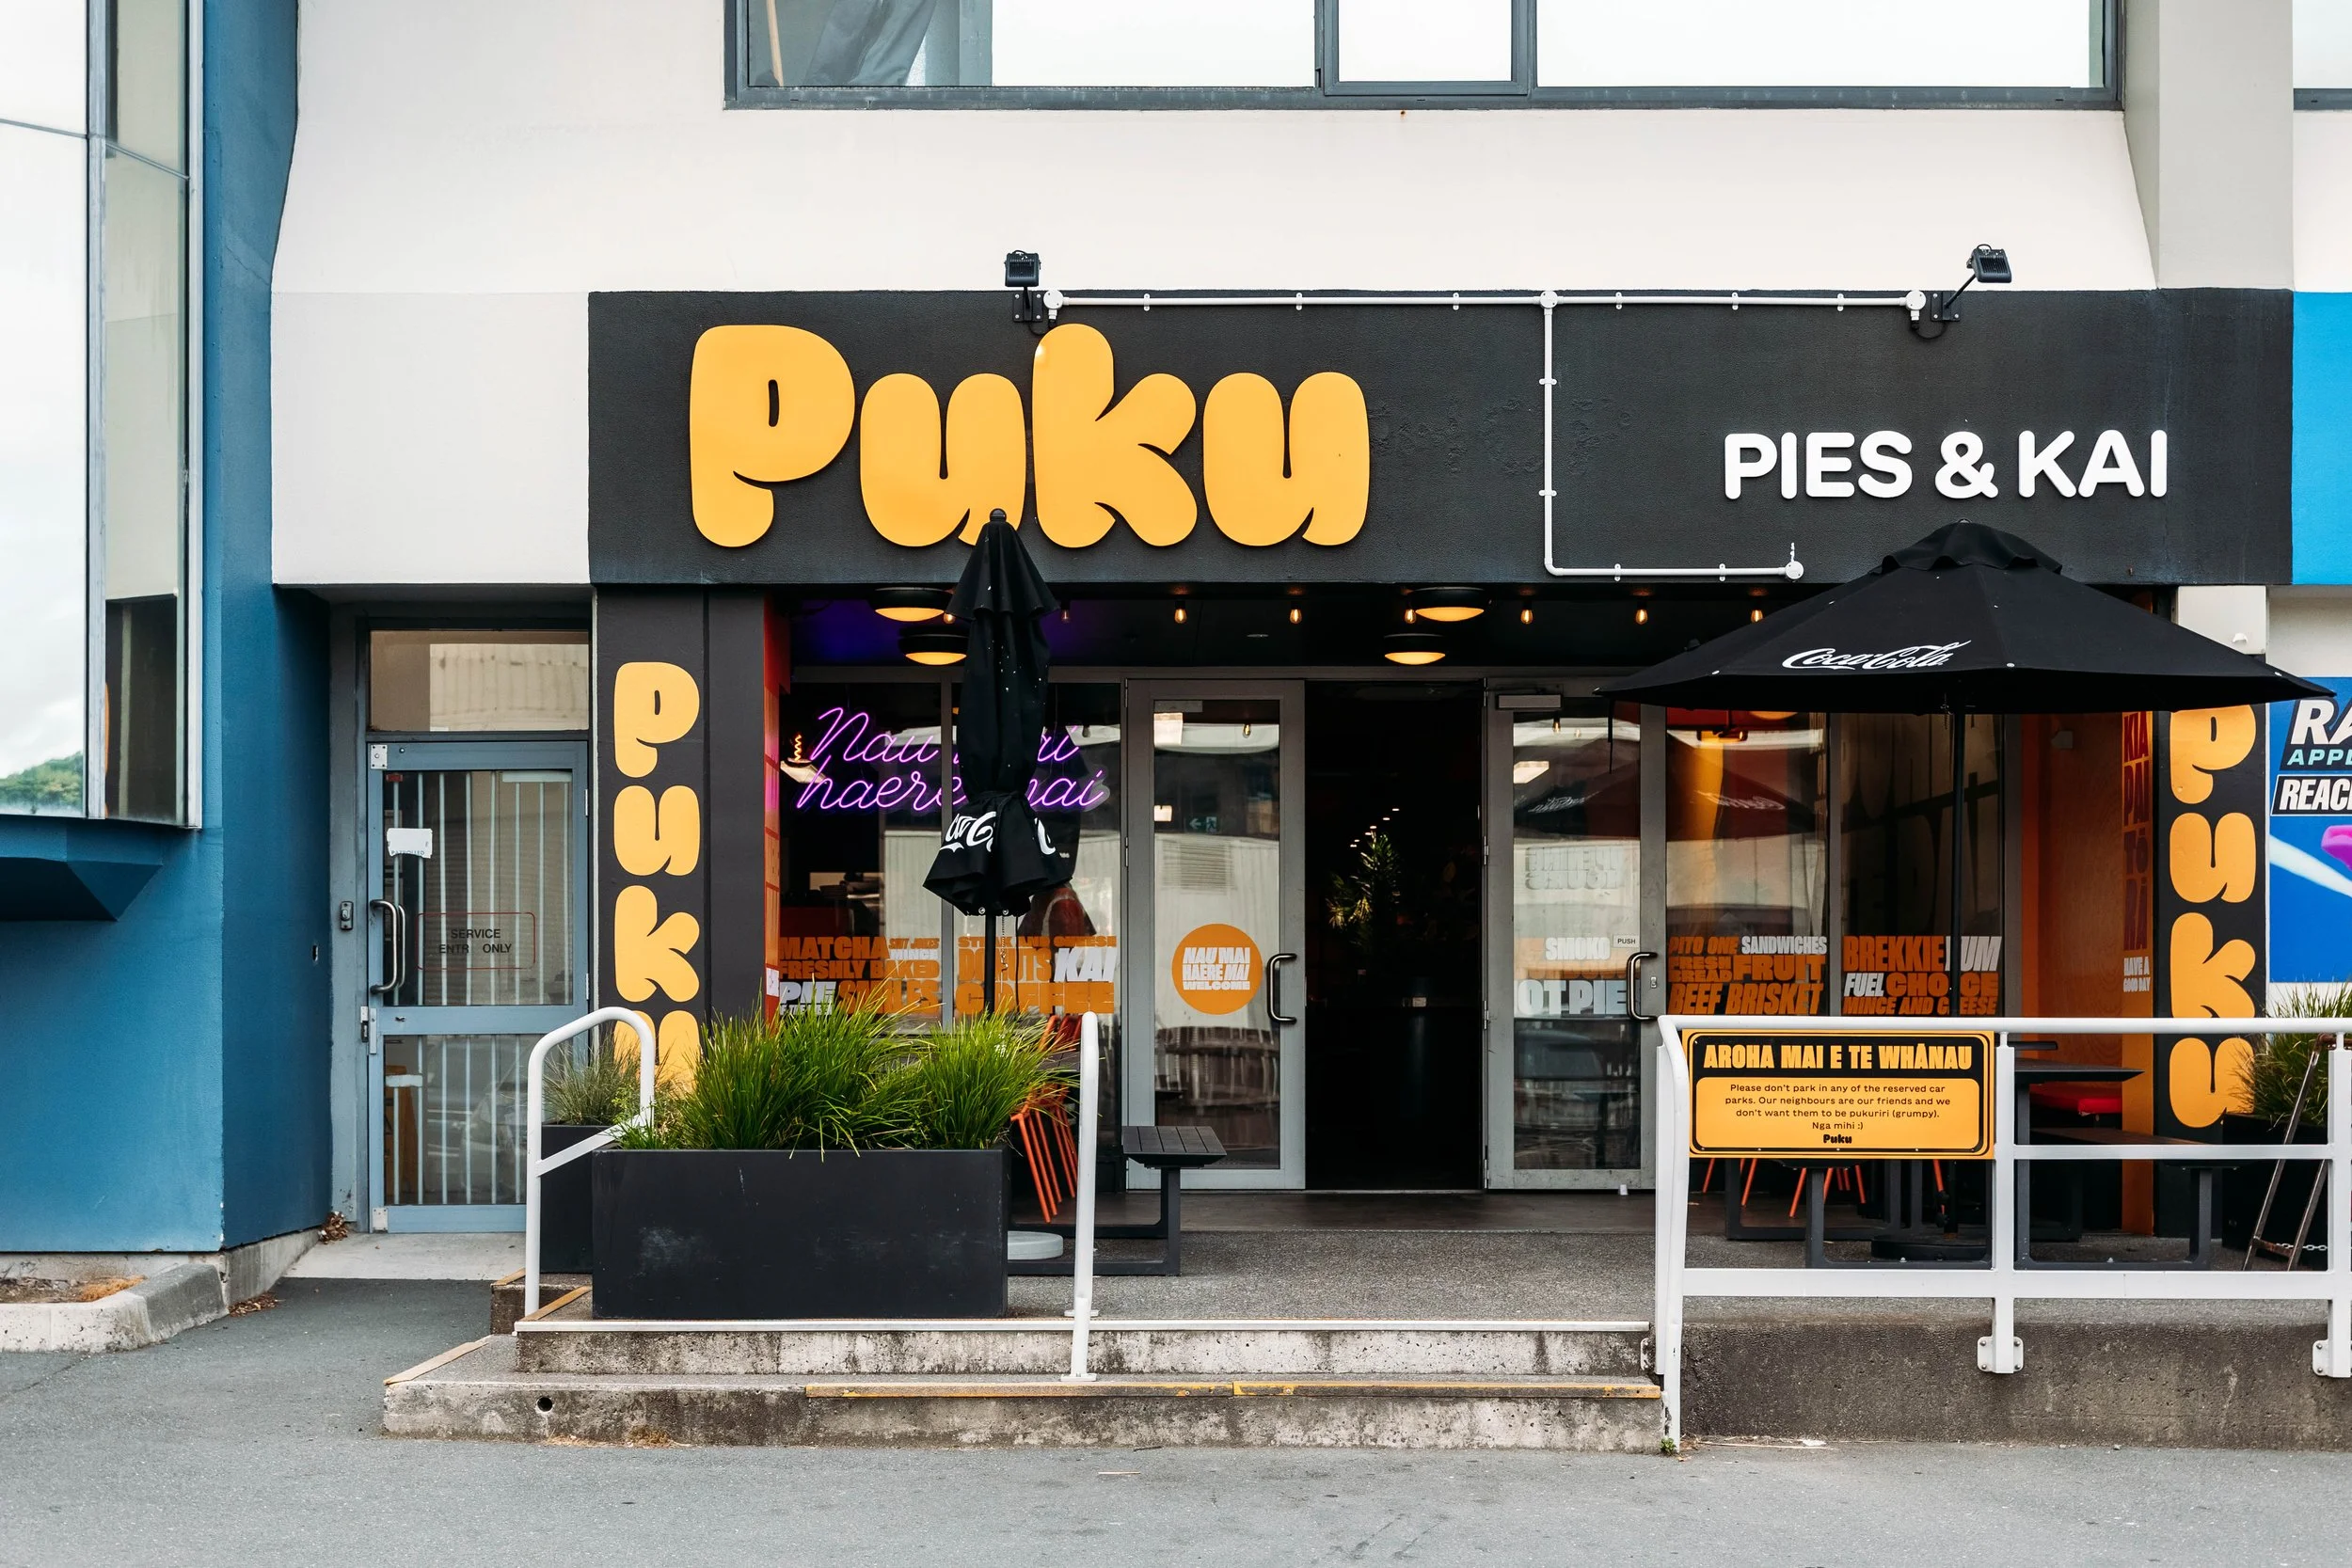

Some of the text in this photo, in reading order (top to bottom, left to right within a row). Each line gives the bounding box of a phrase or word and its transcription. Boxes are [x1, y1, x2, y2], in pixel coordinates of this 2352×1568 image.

[690, 324, 1370, 547] Puku
[1724, 430, 2167, 499] PIES & KAI
[811, 707, 939, 763] Nau
[451, 928, 501, 939] SERVICE
[482, 943, 512, 954] ONLY
[780, 936, 890, 960] MATCHA
[1183, 947, 1250, 963] NAU MAI
[1546, 937, 1611, 960] SMOKO
[1741, 936, 1827, 955] SANDWICHES
[1843, 936, 1945, 972] BREKKIE
[780, 960, 866, 979] FRESHLY
[1054, 947, 1118, 983] KAI
[1183, 964, 1223, 981] HAERE
[1734, 956, 1826, 981] FRUIT
[1183, 981, 1250, 990] WELCOME
[1844, 973, 1999, 997] FUEL CHOCE
[1515, 980, 1566, 1015] OT
[1668, 983, 1824, 1015] BEEF BRISKET
[1843, 997, 1998, 1016] MINCE AND CEESE
[1704, 1043, 1972, 1069] AROHA MAI E TE WHĀNAU
[1793, 1085, 1816, 1094] park
[1831, 1086, 1848, 1095] any
[1883, 1085, 1926, 1093] reserved
[1725, 1097, 1756, 1106] parks.
[1780, 1097, 1835, 1107] neighbours
[1877, 1097, 1912, 1105] friends
[1850, 1110, 1888, 1119] pukuriri
[1893, 1110, 1939, 1119] (grumpy).
[1813, 1122, 1831, 1132] Nga
[1823, 1134, 1852, 1144] Puku
